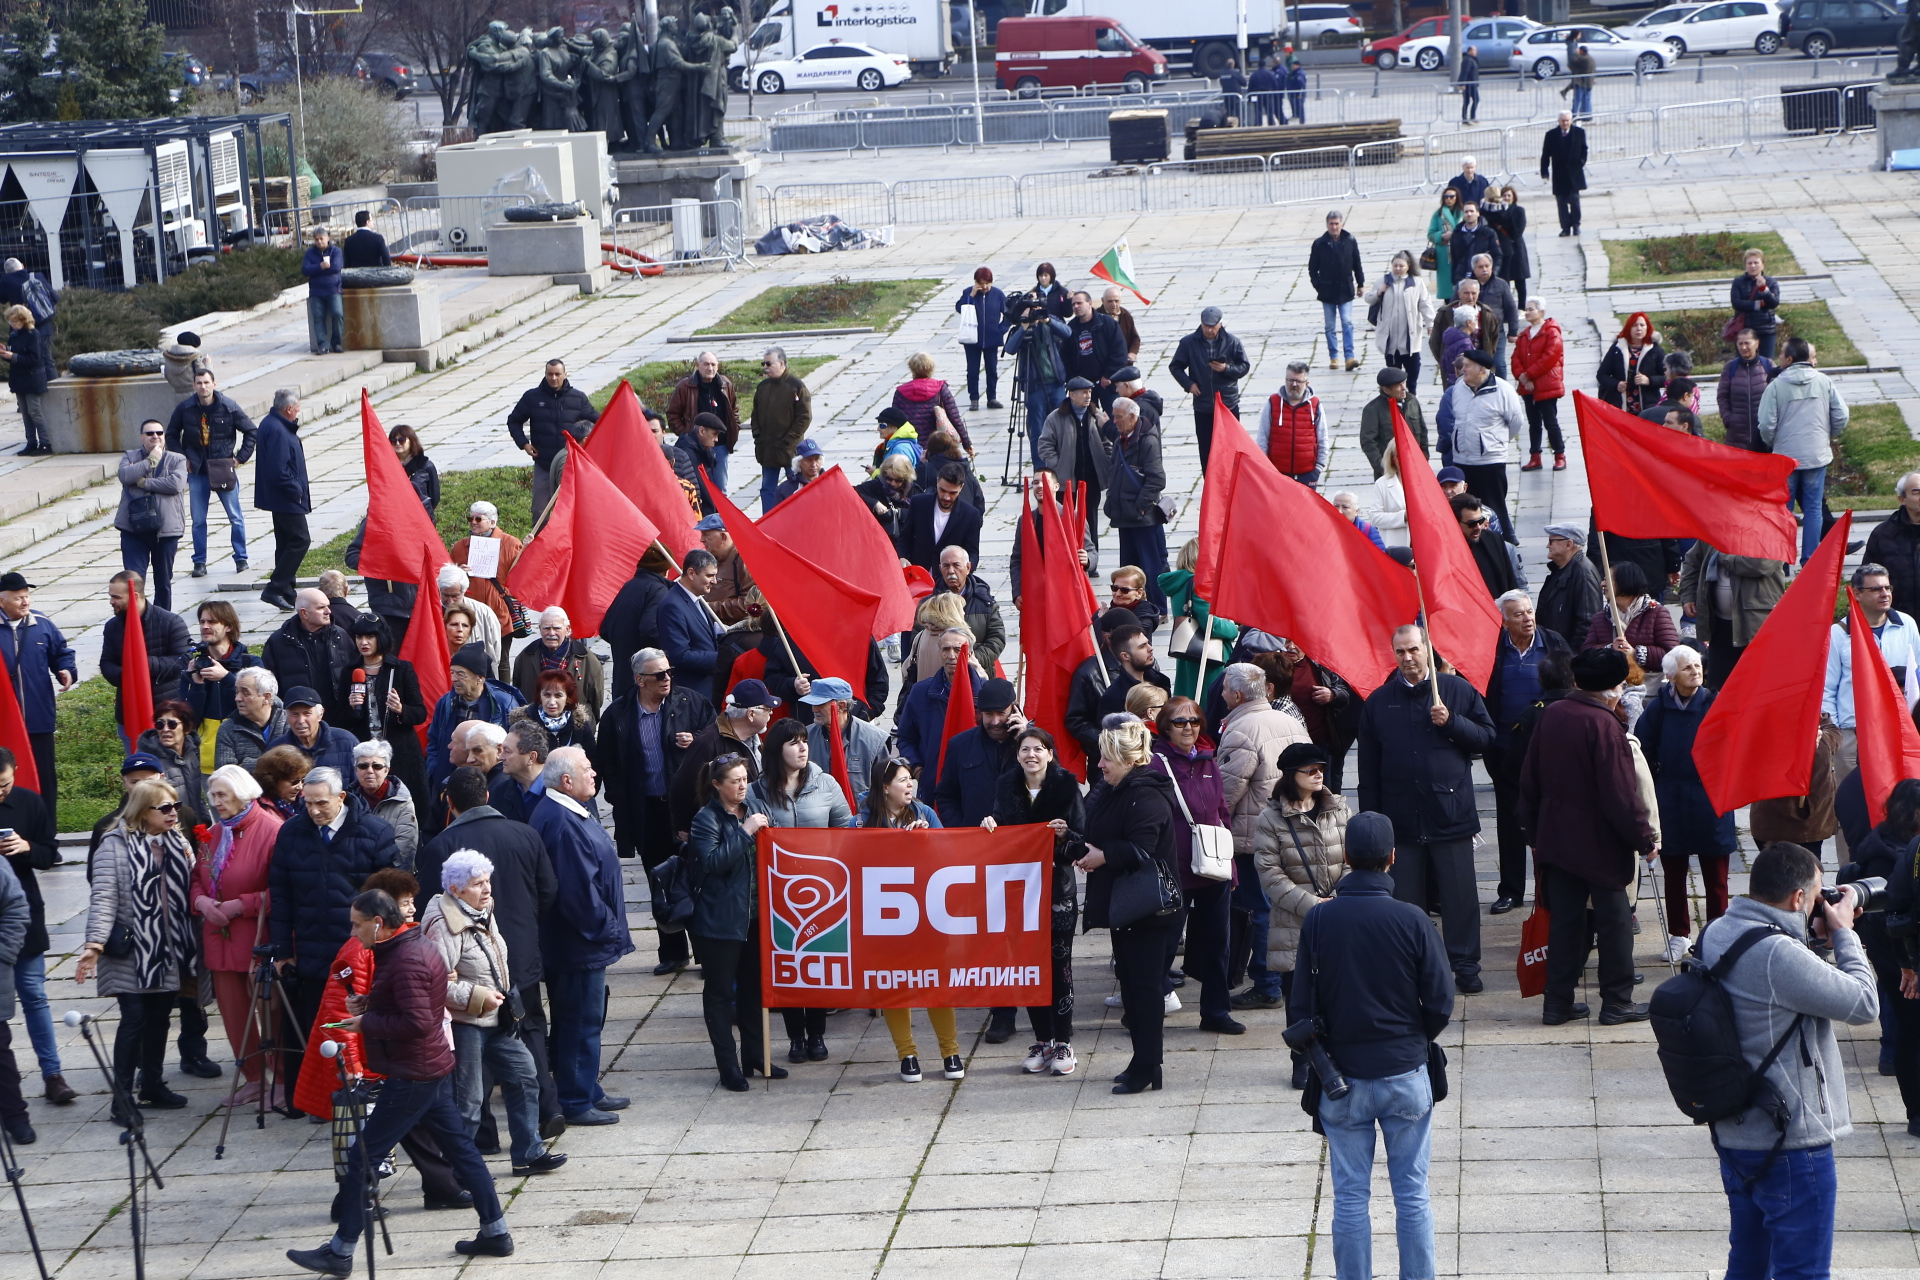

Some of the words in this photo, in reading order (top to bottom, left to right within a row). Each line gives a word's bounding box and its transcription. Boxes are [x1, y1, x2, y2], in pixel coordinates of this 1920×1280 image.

[835, 15, 917, 27] interlogistica
[796, 70, 852, 78] ЖАНДАРМЕРИЯ
[862, 862, 1042, 936] БСП
[804, 923, 819, 938] 1891
[774, 953, 849, 986] БСП
[863, 969, 939, 989] ГОРНА
[948, 966, 1040, 987] МАЛИНА
